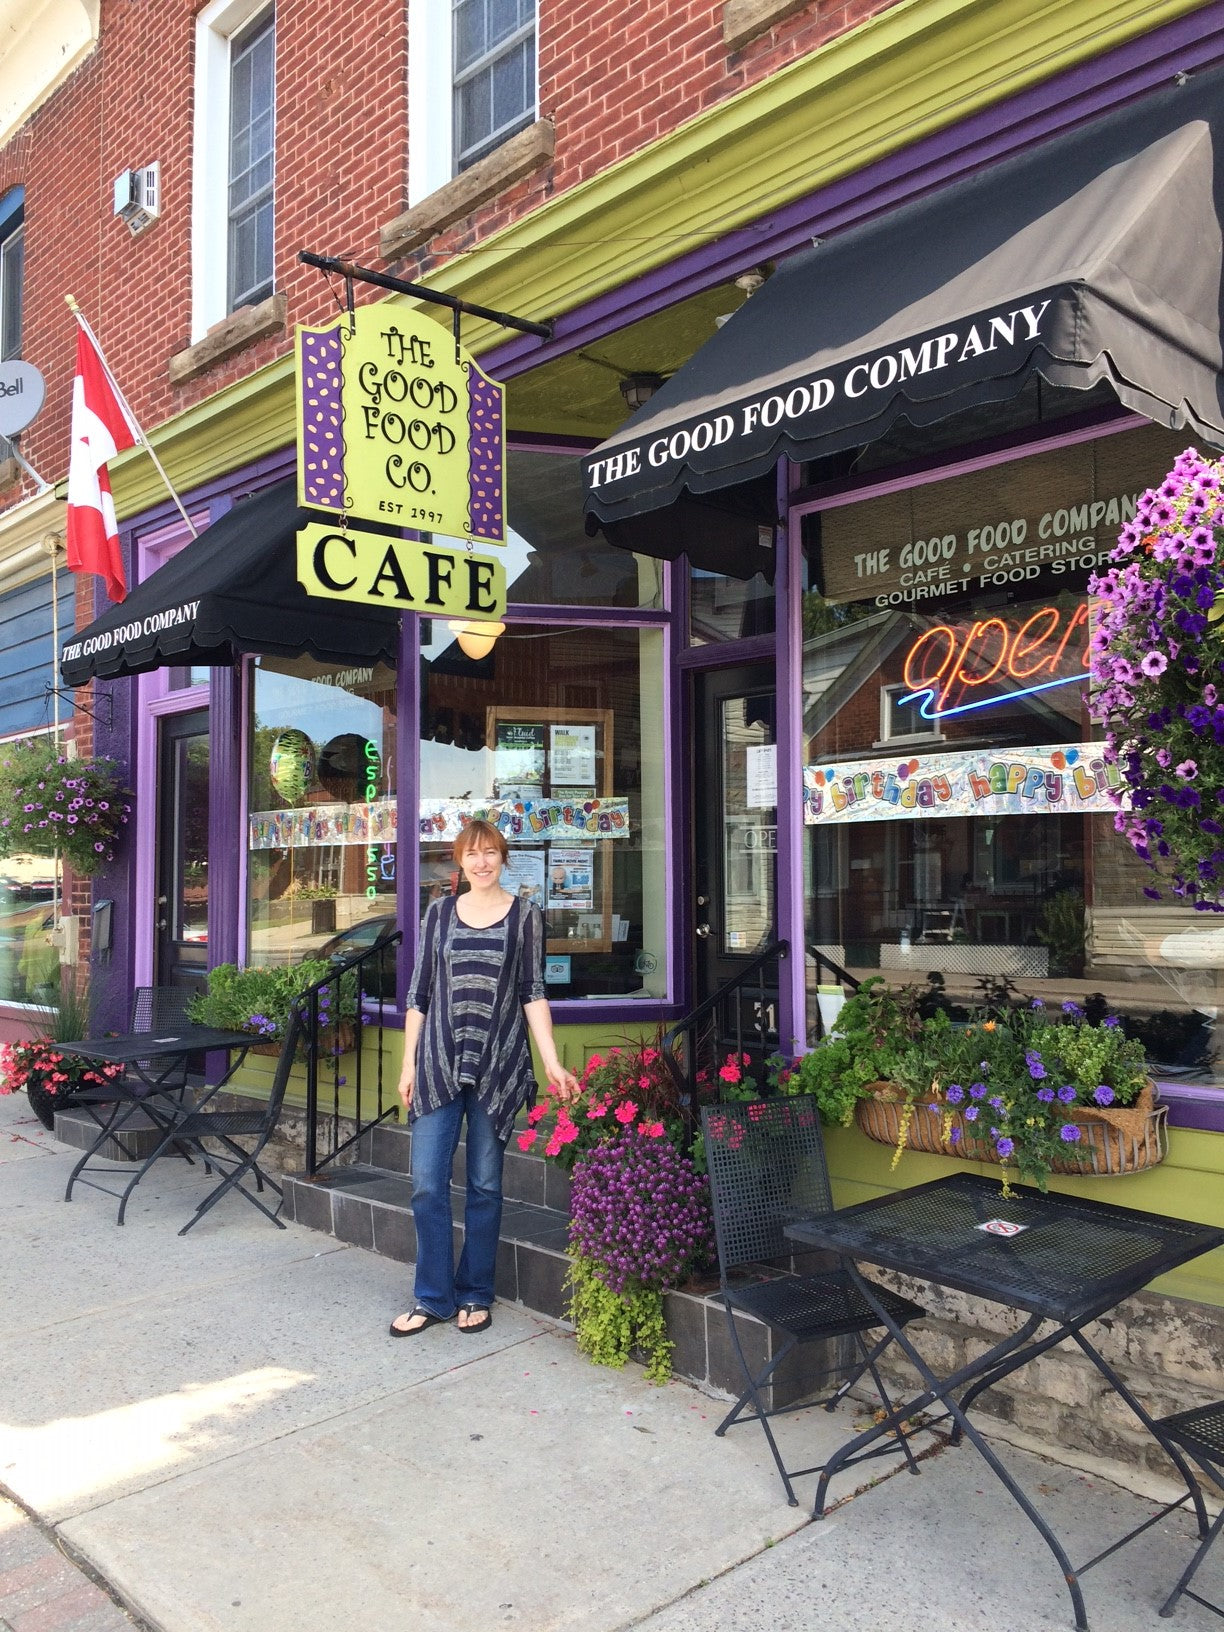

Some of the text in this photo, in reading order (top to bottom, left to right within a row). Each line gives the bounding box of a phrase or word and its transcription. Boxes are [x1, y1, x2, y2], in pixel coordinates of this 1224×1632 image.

[381, 326, 434, 368] THE
[0, 377, 23, 398] Bell
[358, 362, 458, 414] GOOD
[587, 299, 1052, 489] THE GOOD FOOD COMPANY
[361, 405, 456, 454] FOOD
[385, 454, 436, 495] CO.
[378, 500, 443, 524] EST 1997
[853, 491, 1144, 578] THE GOOD FOOD COMPAN
[312, 534, 497, 614] CAFE
[900, 536, 1096, 587] CAFÉ CATERING
[875, 577, 971, 608] GOURMET
[979, 565, 1041, 588] FOOD
[62, 600, 200, 662] THE GOOD FOOD COMPANY
[335, 668, 374, 687] COMPANY
[830, 771, 952, 813] birthday
[967, 762, 1064, 802] happy
[528, 805, 625, 834] birthday
[744, 830, 776, 849] OPE
[754, 1001, 777, 1033] 31
